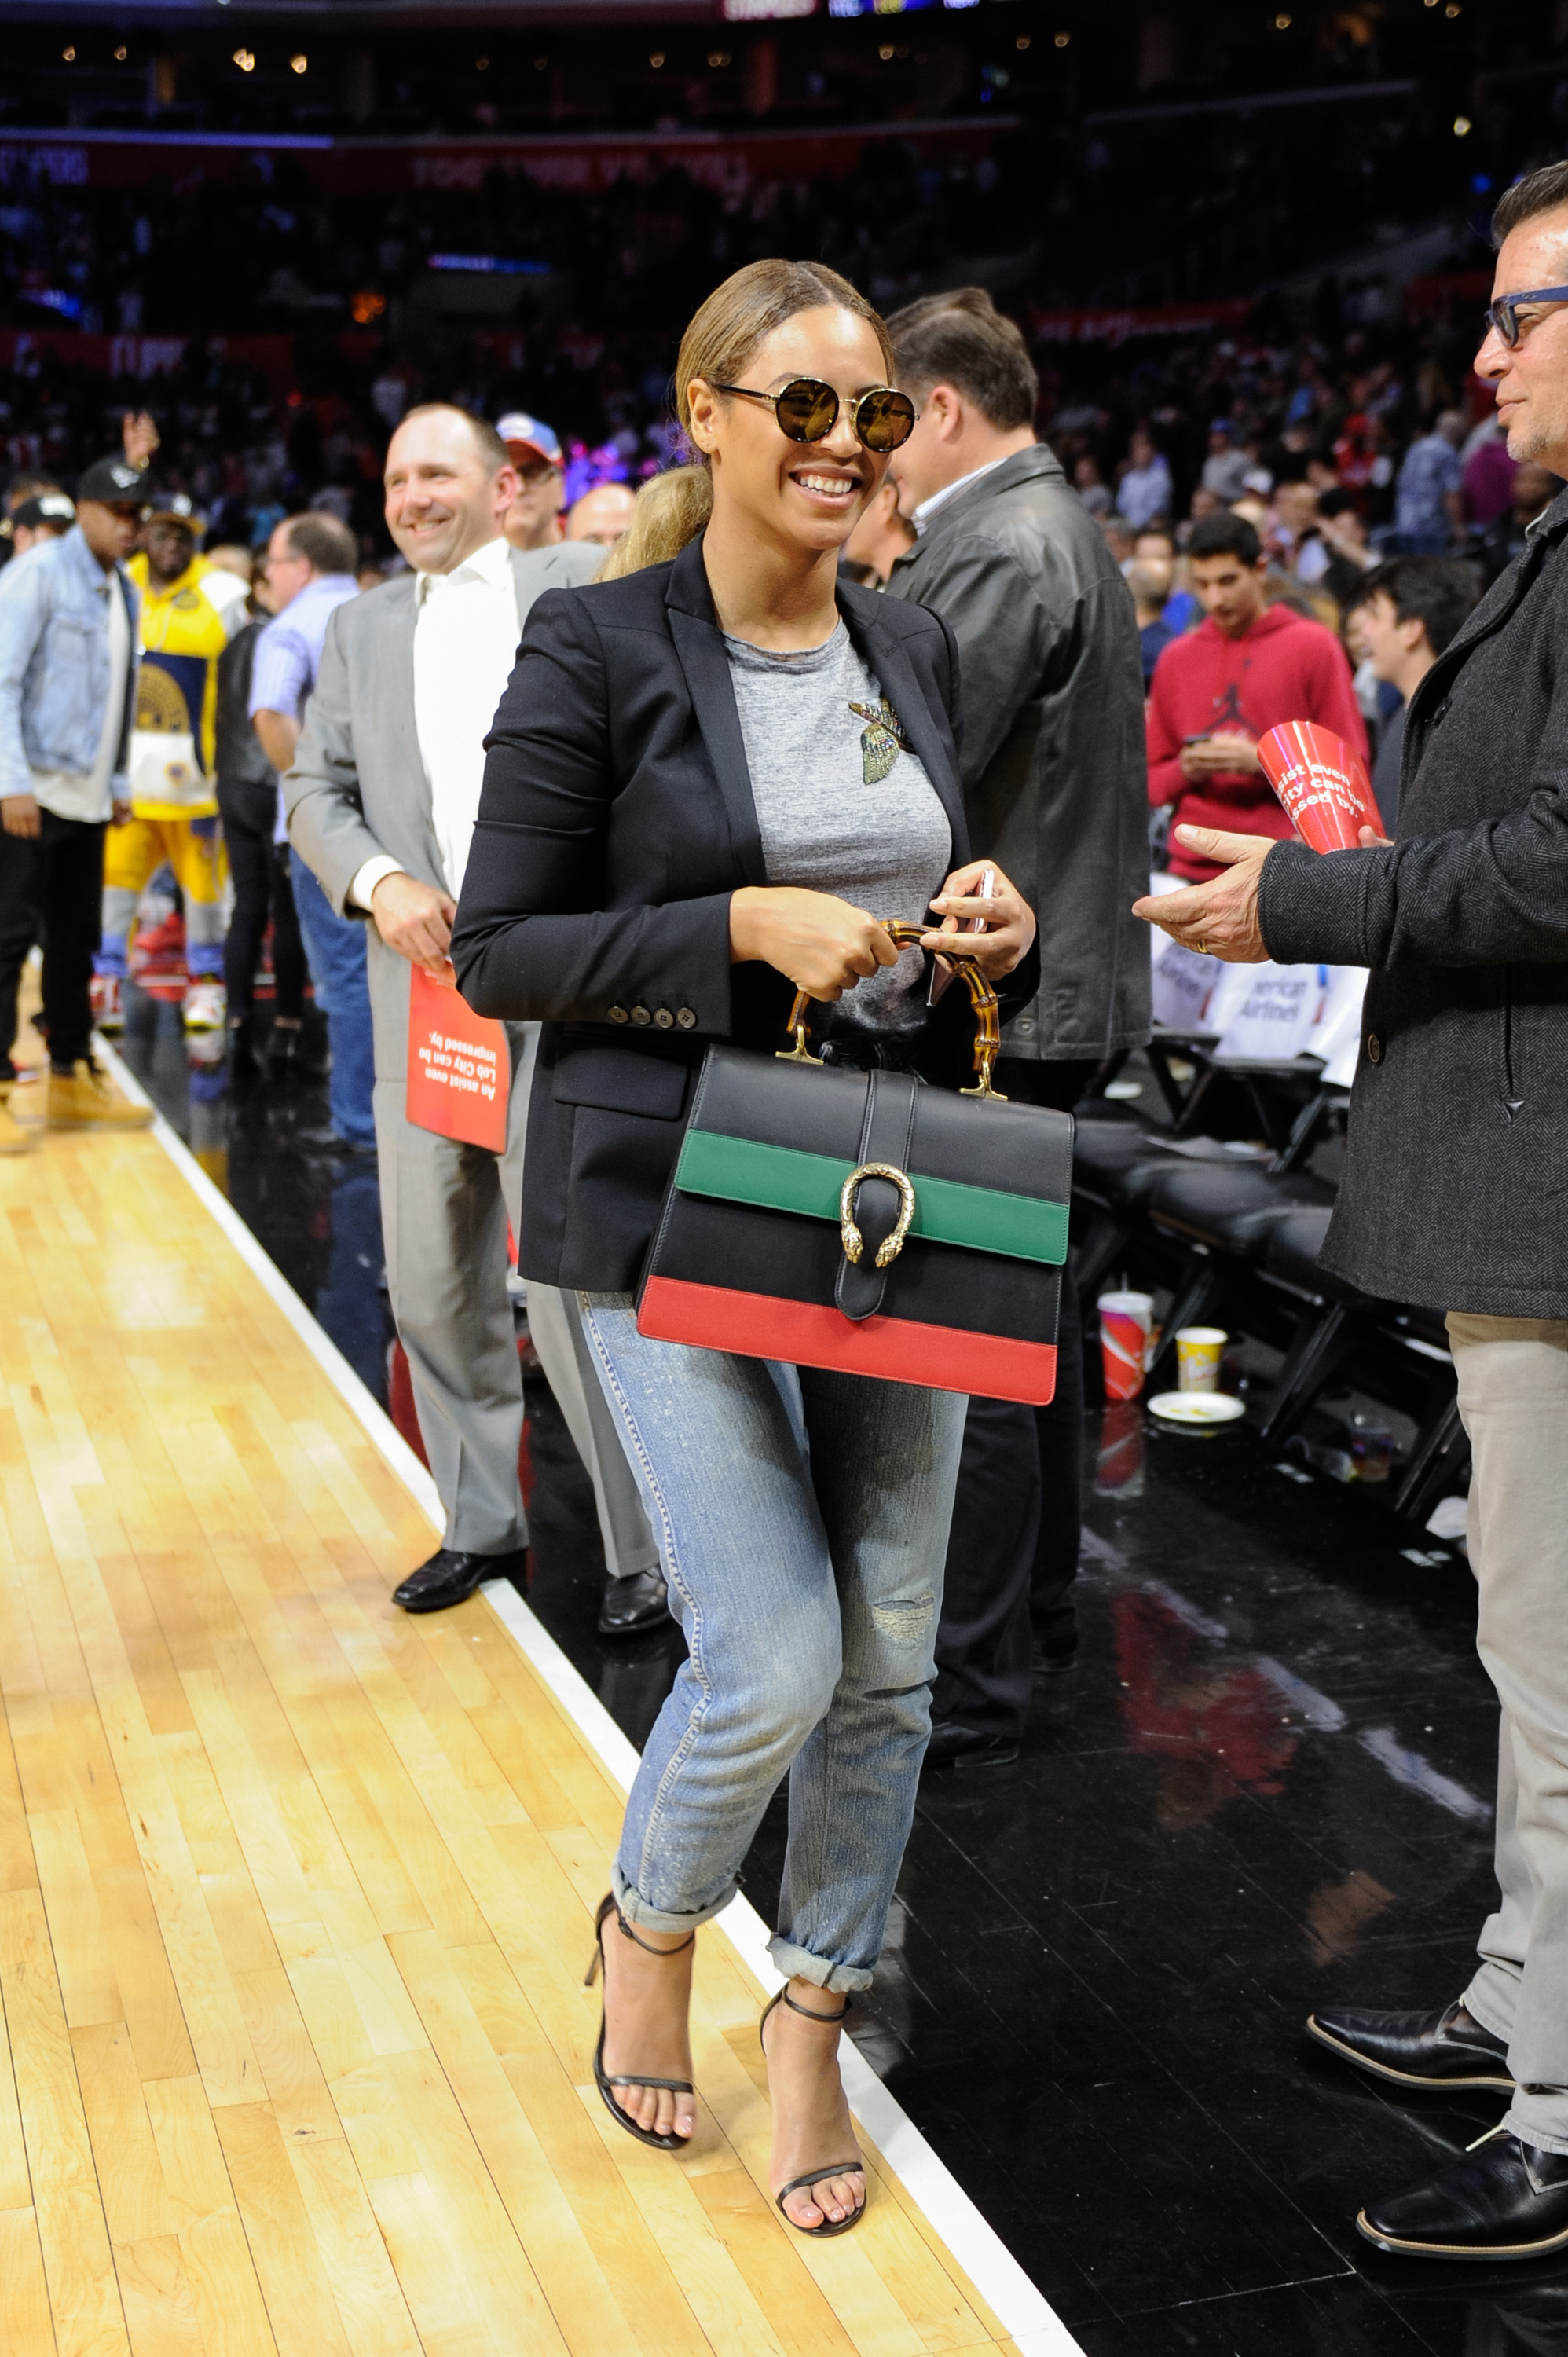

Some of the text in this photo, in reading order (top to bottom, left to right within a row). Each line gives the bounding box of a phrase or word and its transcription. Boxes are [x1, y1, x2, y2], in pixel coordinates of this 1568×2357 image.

[1277, 764, 1350, 794] sist even
[1283, 778, 1365, 812] ity can be
[1336, 794, 1358, 819] by.
[419, 1047, 496, 1083] Lob City can be
[445, 1037, 496, 1066] impressed
[425, 1066, 496, 1101] An assist even
